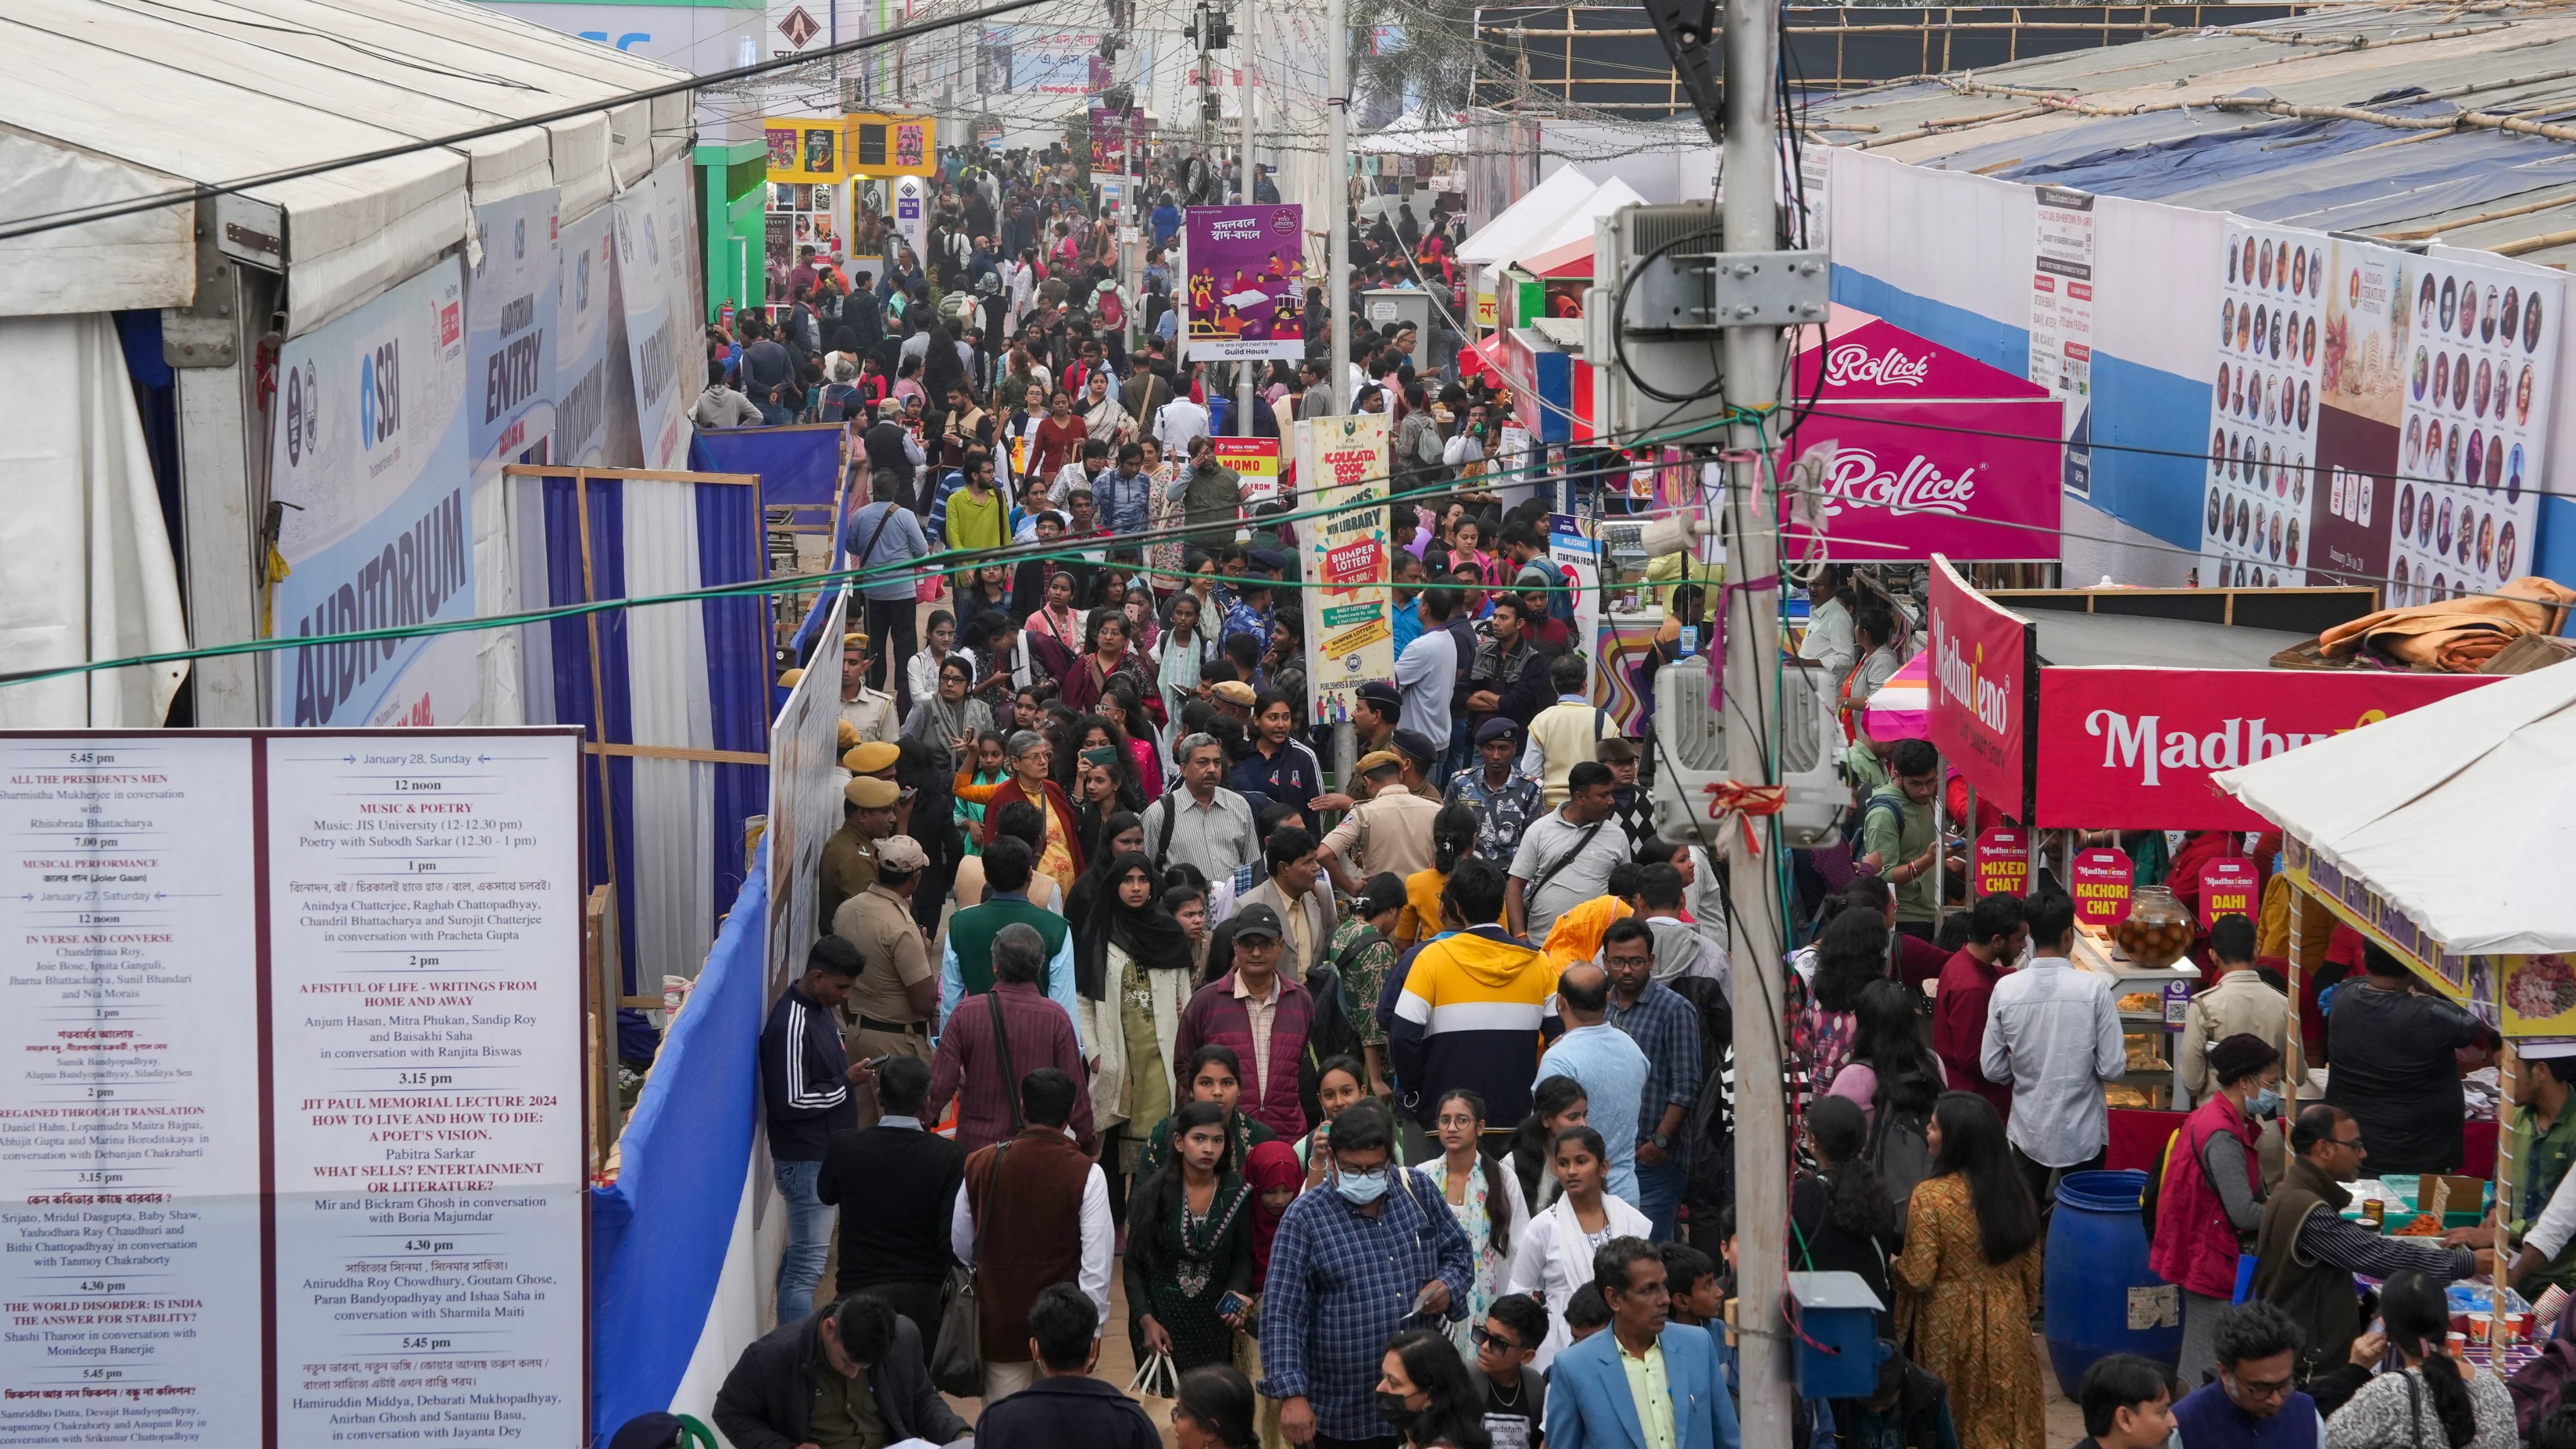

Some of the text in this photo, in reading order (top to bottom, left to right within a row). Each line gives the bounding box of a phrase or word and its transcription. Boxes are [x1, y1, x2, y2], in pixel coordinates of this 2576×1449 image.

[500, 293, 534, 340] AUDITORIUM
[1824, 344, 1928, 387] Rollick
[485, 328, 543, 426] ENTRY
[376, 337, 400, 443] SBI
[1324, 450, 1376, 464] KOLKATA
[1223, 459, 1260, 471] MOMO
[1334, 462, 1367, 476] BOOK
[1820, 448, 1975, 516] Rollick
[1327, 508, 1381, 535] WIN LIBRARY
[1563, 537, 1588, 548] MILKSHAKE
[1331, 544, 1375, 564] BUMPER
[1557, 553, 1595, 567] STARTING FROM
[1336, 555, 1371, 572] LOTTERY
[294, 487, 466, 727] AUDITORIUM
[1332, 624, 1375, 646] BUMPER LOTTERY
[1320, 681, 1345, 691] PUBLISHERS
[70, 753, 115, 765] 5.45 pm
[362, 754, 472, 766] January 28, Sunday
[395, 779, 441, 790] 12 noon
[360, 803, 472, 814] MUSIC & POETRY
[314, 819, 522, 833] Music: JIS University (12-12.30 pm)
[1980, 846, 2027, 856] Madhureno
[23, 859, 159, 869] MUSICAL PERFORMANCE
[1981, 862, 2027, 875] MIXED
[2078, 866, 2127, 877] Madhureno
[1986, 877, 2021, 892] CHAT
[2204, 876, 2253, 887] Madhureno
[2076, 883, 2129, 899] KACHORI
[2087, 900, 2118, 915] CHAT
[2212, 895, 2246, 909] DAHI
[301, 984, 308, 994] A
[311, 983, 366, 993] FISTFUL
[368, 982, 386, 992] OF
[389, 982, 419, 992] LIFE
[429, 982, 496, 992] WRITINGS
[499, 981, 537, 991] FROM
[364, 996, 474, 1007] HOME AND AWAY
[301, 1095, 558, 1111] JIT PAUL MEMORIAL LECTURE 2024
[369, 1129, 492, 1141] A POET'S VISION.
[3, 1299, 203, 1312] THE WORLD DISORDER: IS INDIA
[13, 1313, 196, 1326] THE ANSWER FOR STABILITY?
